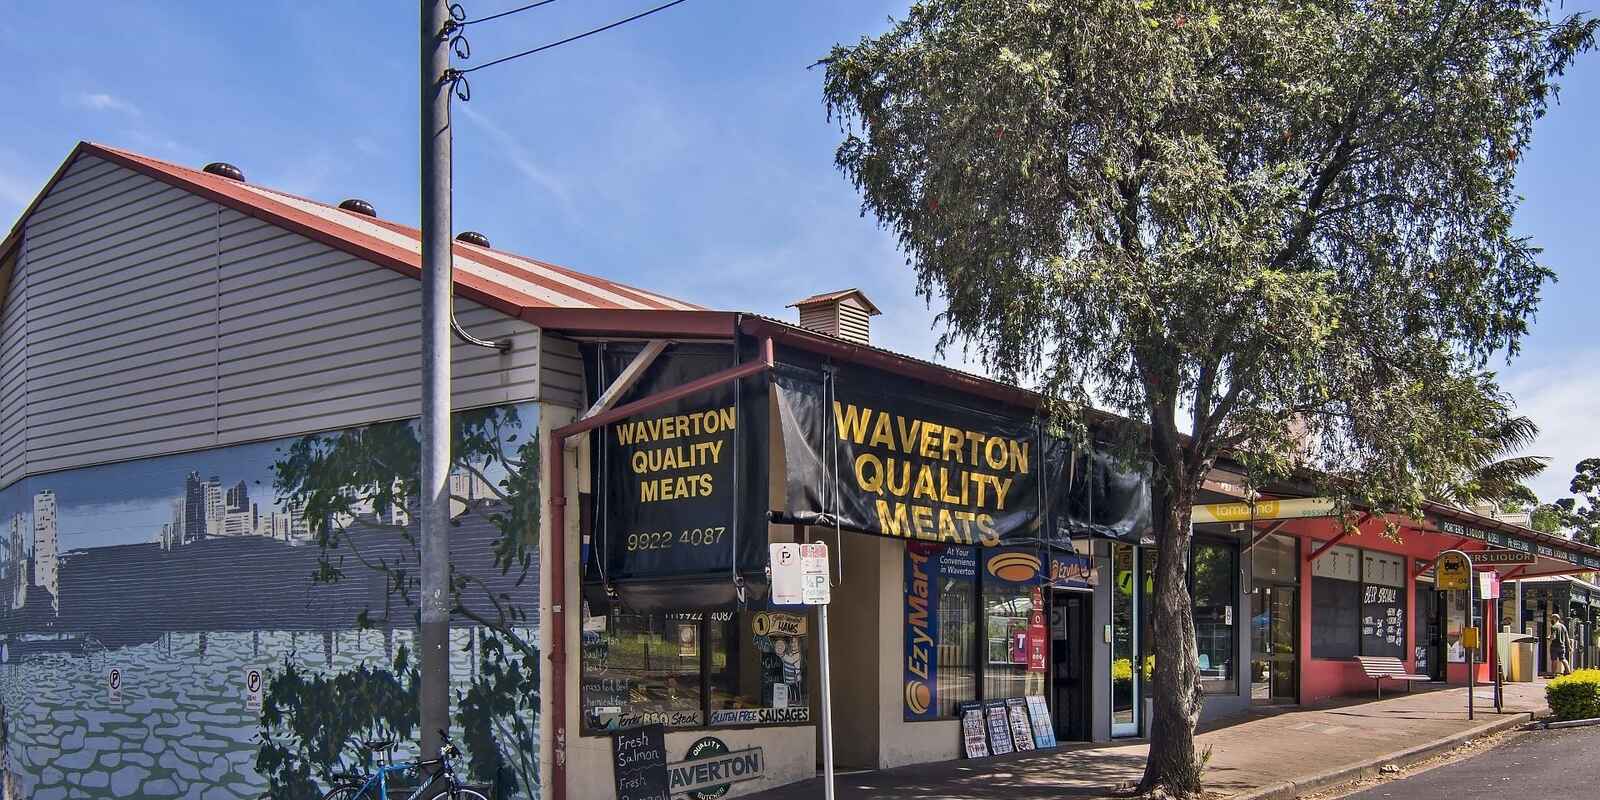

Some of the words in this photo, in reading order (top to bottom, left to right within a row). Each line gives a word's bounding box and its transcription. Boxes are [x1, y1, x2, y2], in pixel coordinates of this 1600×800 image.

[616, 406, 736, 446] WAVERTON
[833, 400, 1029, 474] WAVERTON
[632, 440, 723, 474] QUALITY
[640, 473, 713, 503] MEATS
[855, 453, 1012, 510] QUALITY
[876, 500, 1000, 547] MEATS
[1443, 522, 1464, 535] PORTERS
[1466, 526, 1485, 540] LIQUOR
[627, 531, 672, 551] 9922
[679, 526, 725, 546] 4087
[946, 548, 955, 556] At
[956, 549, 969, 557] Your
[1490, 553, 1531, 562] LIQUOR
[940, 556, 976, 568] Convenience
[941, 566, 947, 574] in
[948, 567, 975, 576] Waverton
[908, 551, 934, 680] EzyMart
[672, 711, 698, 726] Steak
[711, 711, 737, 725] GLUTEN
[738, 710, 758, 724] FREE
[758, 708, 809, 724] SAUSAGES
[618, 731, 649, 750] Fresh
[693, 740, 721, 757] QUALITY
[618, 749, 660, 767] Salmon
[619, 776, 647, 791] Fresh
